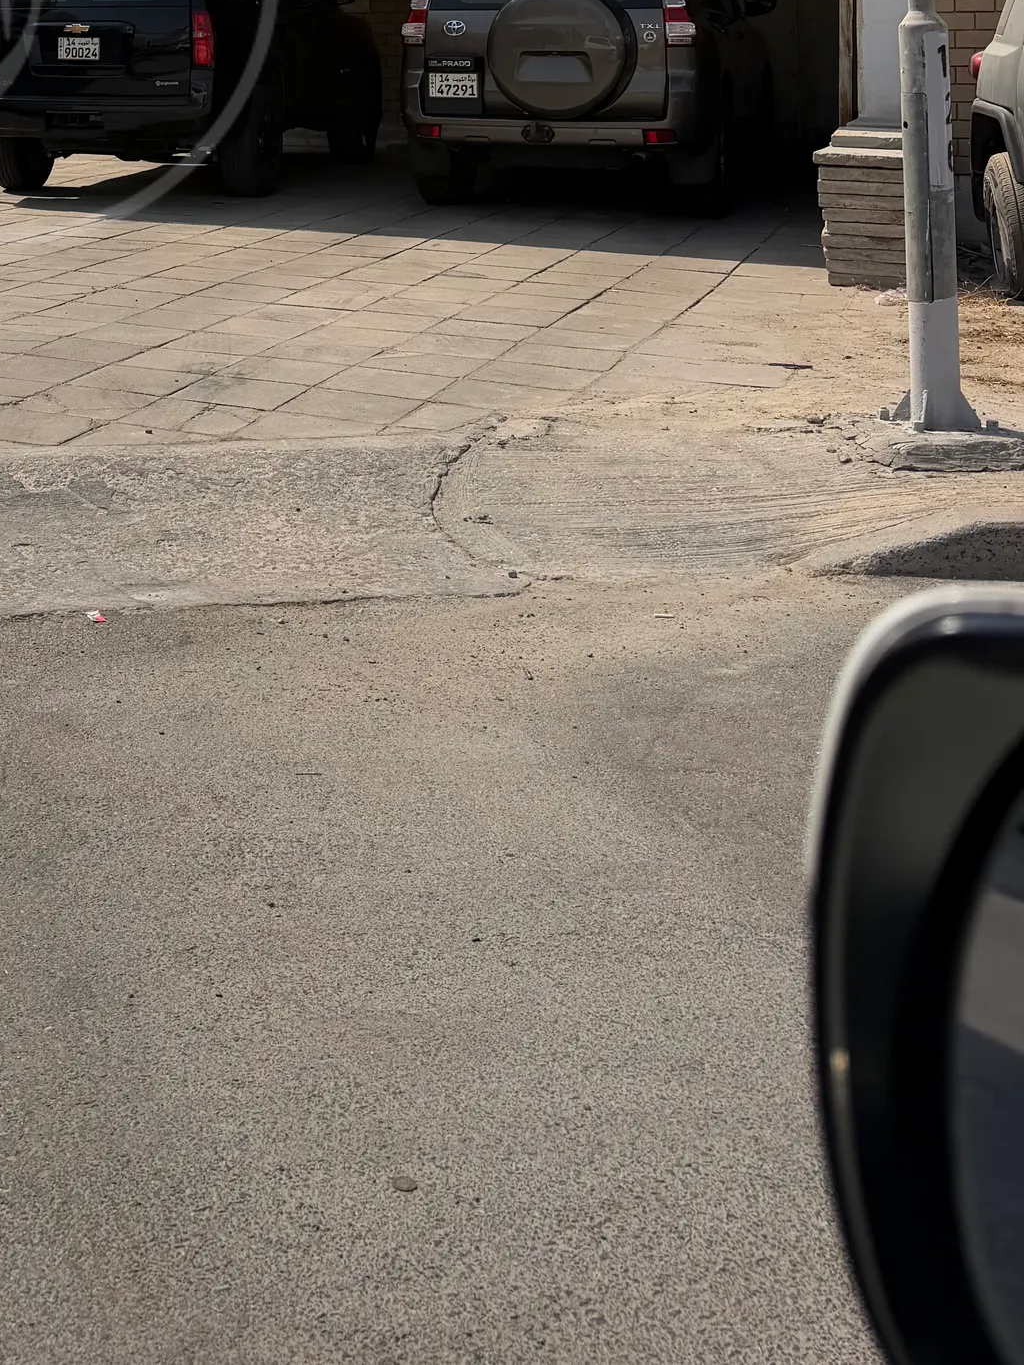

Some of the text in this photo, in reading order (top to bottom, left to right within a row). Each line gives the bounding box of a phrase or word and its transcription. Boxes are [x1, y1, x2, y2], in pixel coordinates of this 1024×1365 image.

[66, 37, 76, 47] 14
[64, 47, 98, 59] 90024
[439, 74, 450, 83] 14
[437, 84, 476, 97] 47291
